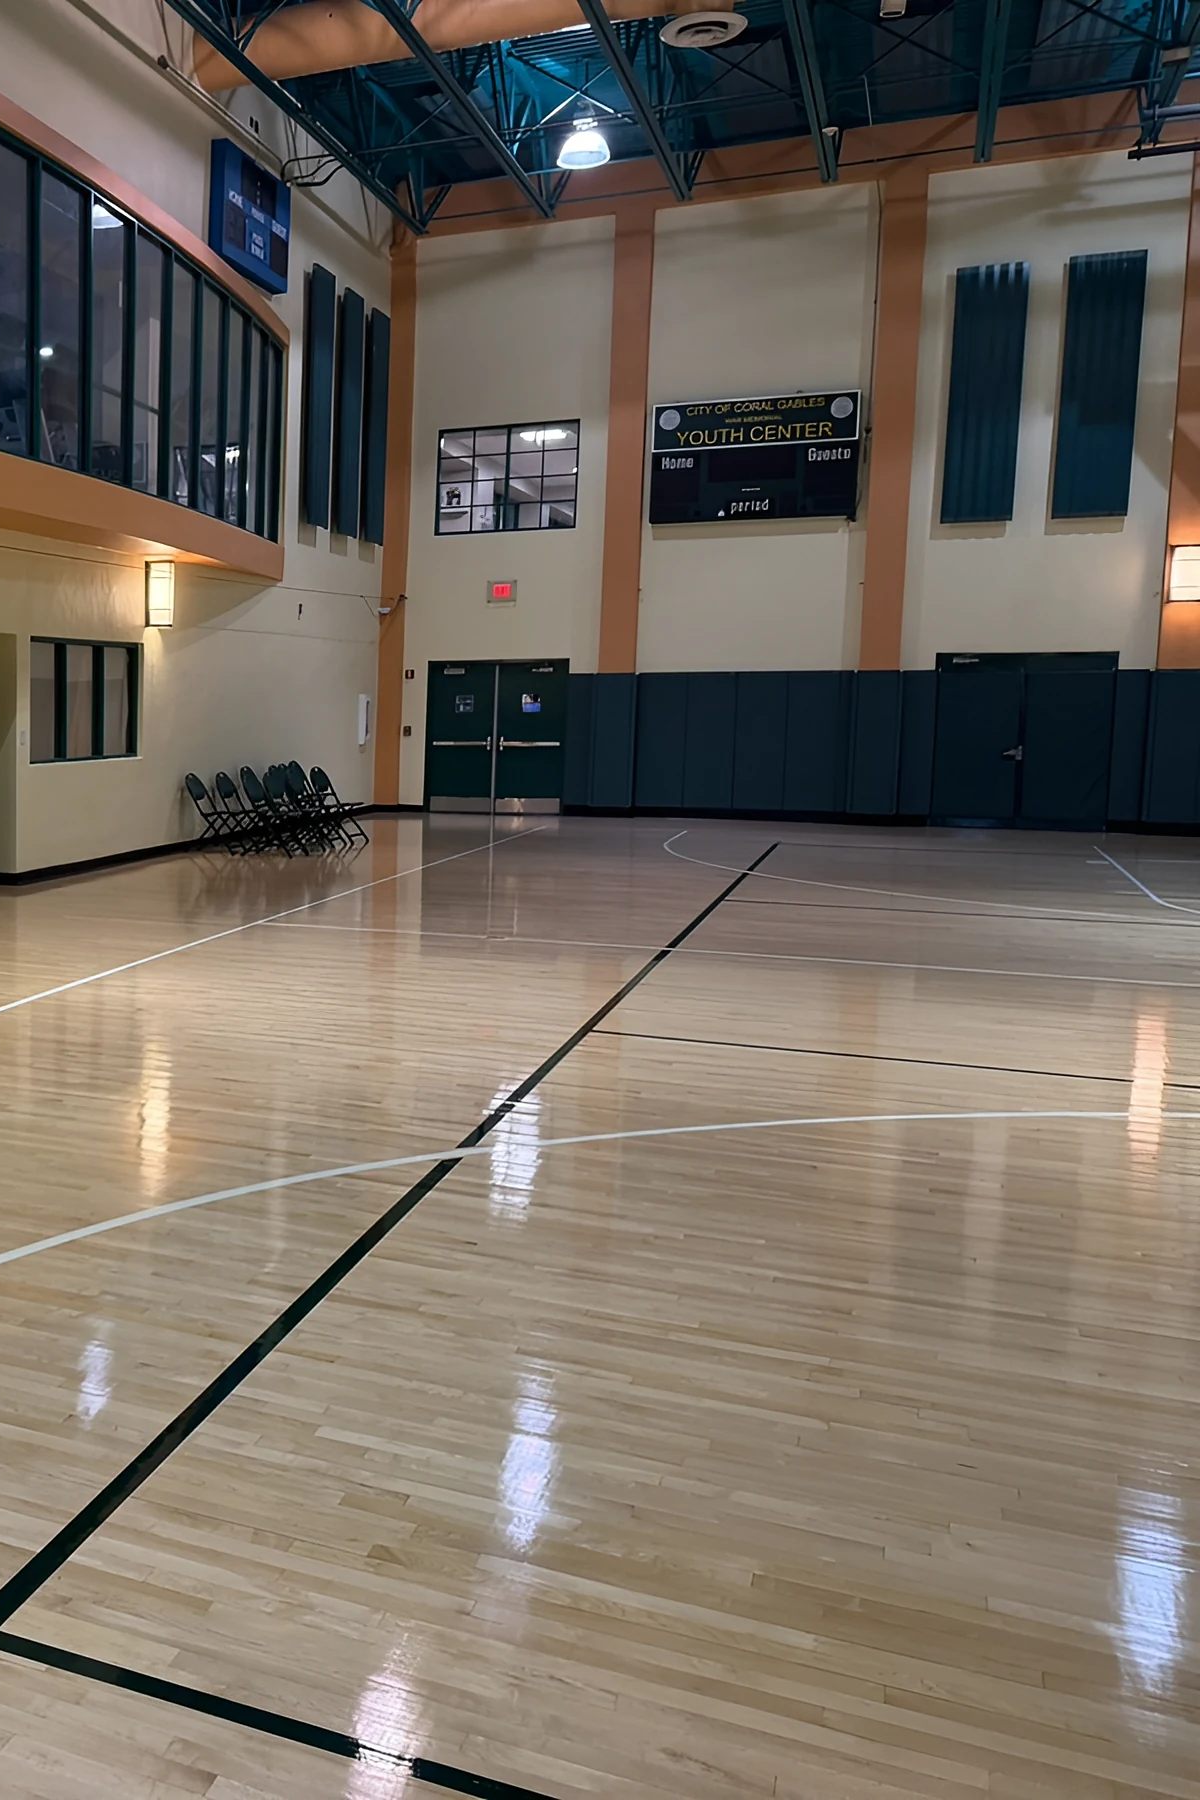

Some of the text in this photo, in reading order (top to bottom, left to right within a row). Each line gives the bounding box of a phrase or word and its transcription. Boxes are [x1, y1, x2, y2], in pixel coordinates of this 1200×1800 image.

[686, 396, 826, 417] CITY OF CORAL GABLES
[677, 421, 833, 446] YOUTH CENTER
[661, 456, 694, 470] Home
